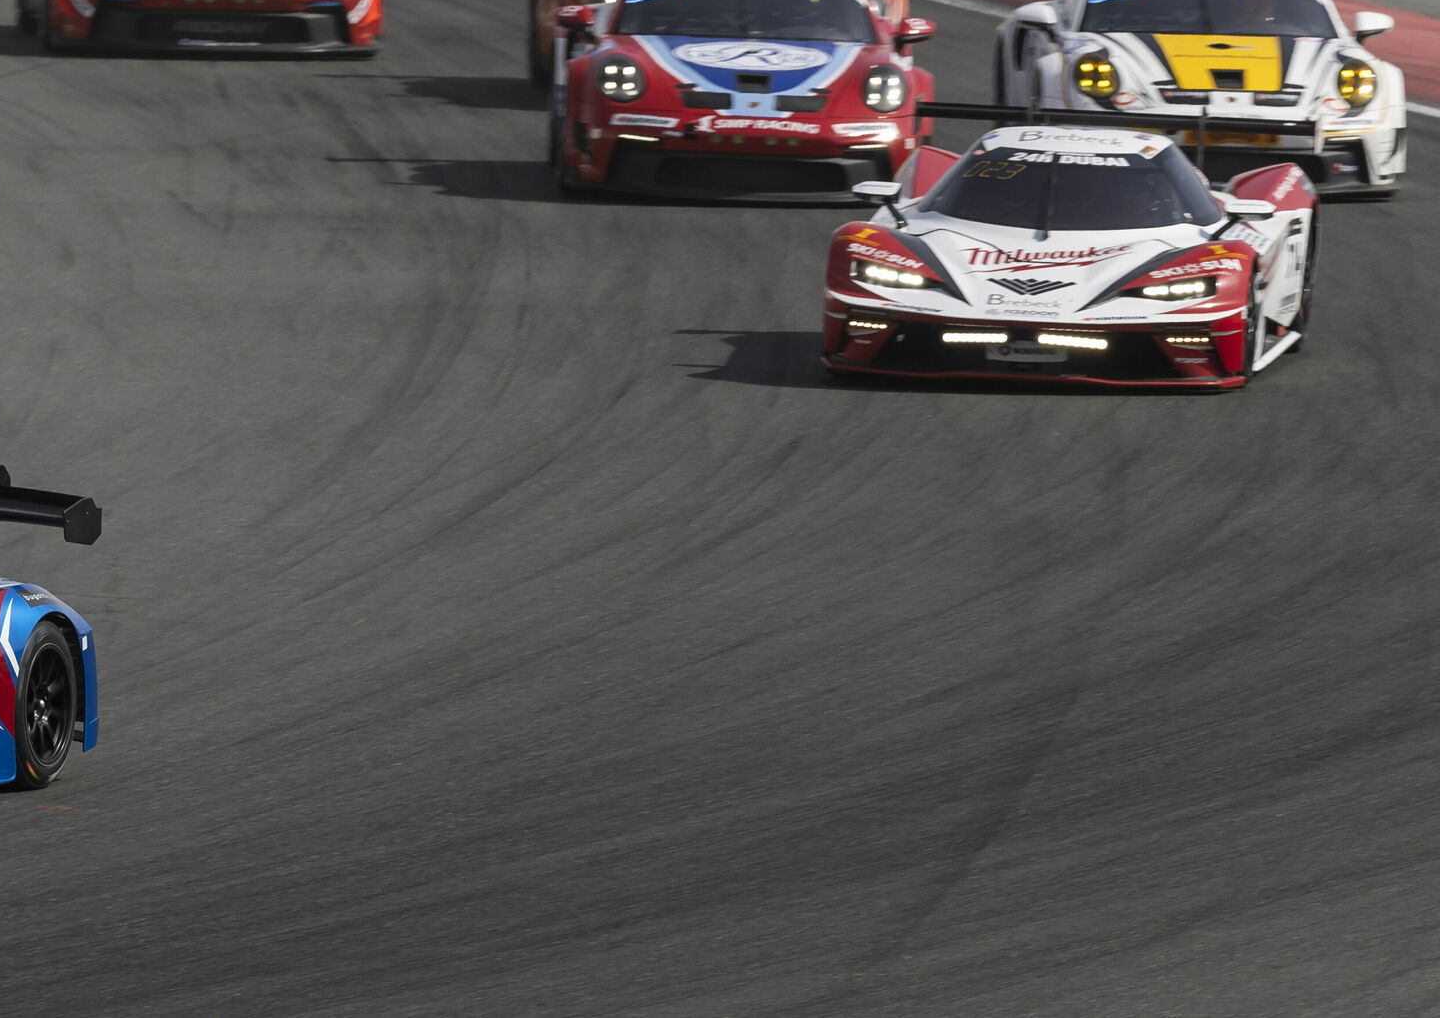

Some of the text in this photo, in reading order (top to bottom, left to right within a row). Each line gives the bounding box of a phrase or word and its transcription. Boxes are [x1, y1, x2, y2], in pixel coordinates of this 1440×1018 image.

[753, 120, 821, 134] RACING
[1018, 130, 1124, 147] Brebeck
[1007, 151, 1131, 168] 24H DUBAI
[962, 160, 1028, 181] 023
[962, 244, 1133, 267] Milwaukee
[986, 293, 1063, 309] Brebeck
